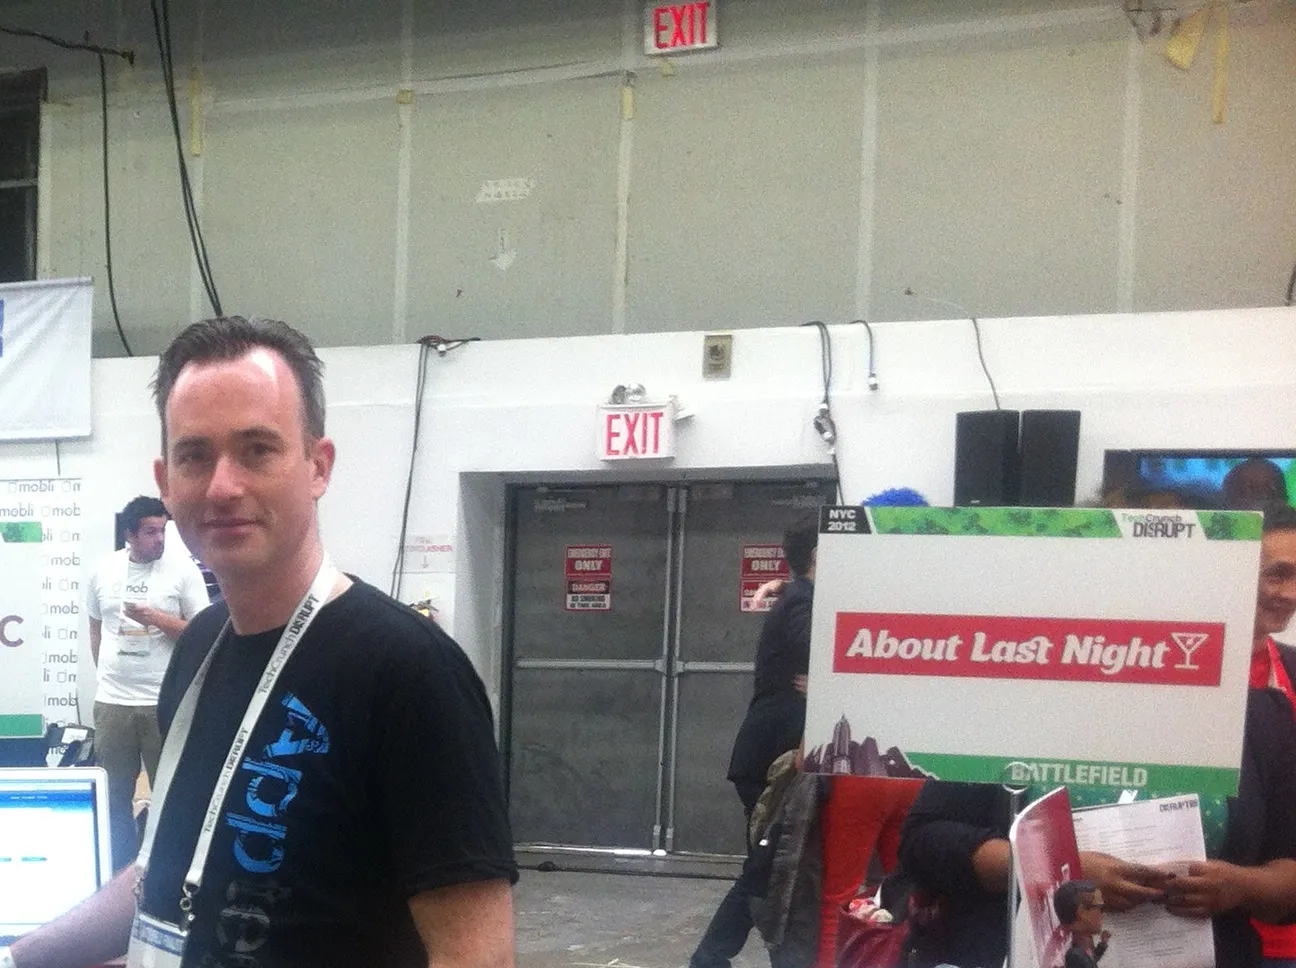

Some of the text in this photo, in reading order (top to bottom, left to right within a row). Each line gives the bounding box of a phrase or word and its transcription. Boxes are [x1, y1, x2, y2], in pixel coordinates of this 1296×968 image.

[653, 1, 711, 49] EXIT
[606, 412, 664, 456] EXIT
[18, 480, 54, 493] mobli
[829, 509, 856, 519] NYC
[828, 521, 856, 531] 2012
[1132, 522, 1196, 538] DISRUPT
[574, 559, 603, 571] ONLY
[751, 559, 782, 571] ONLY
[288, 593, 320, 636] DISRUPT
[847, 627, 1170, 675] About Last Night
[1011, 762, 1148, 788] BATTLEFIELD
